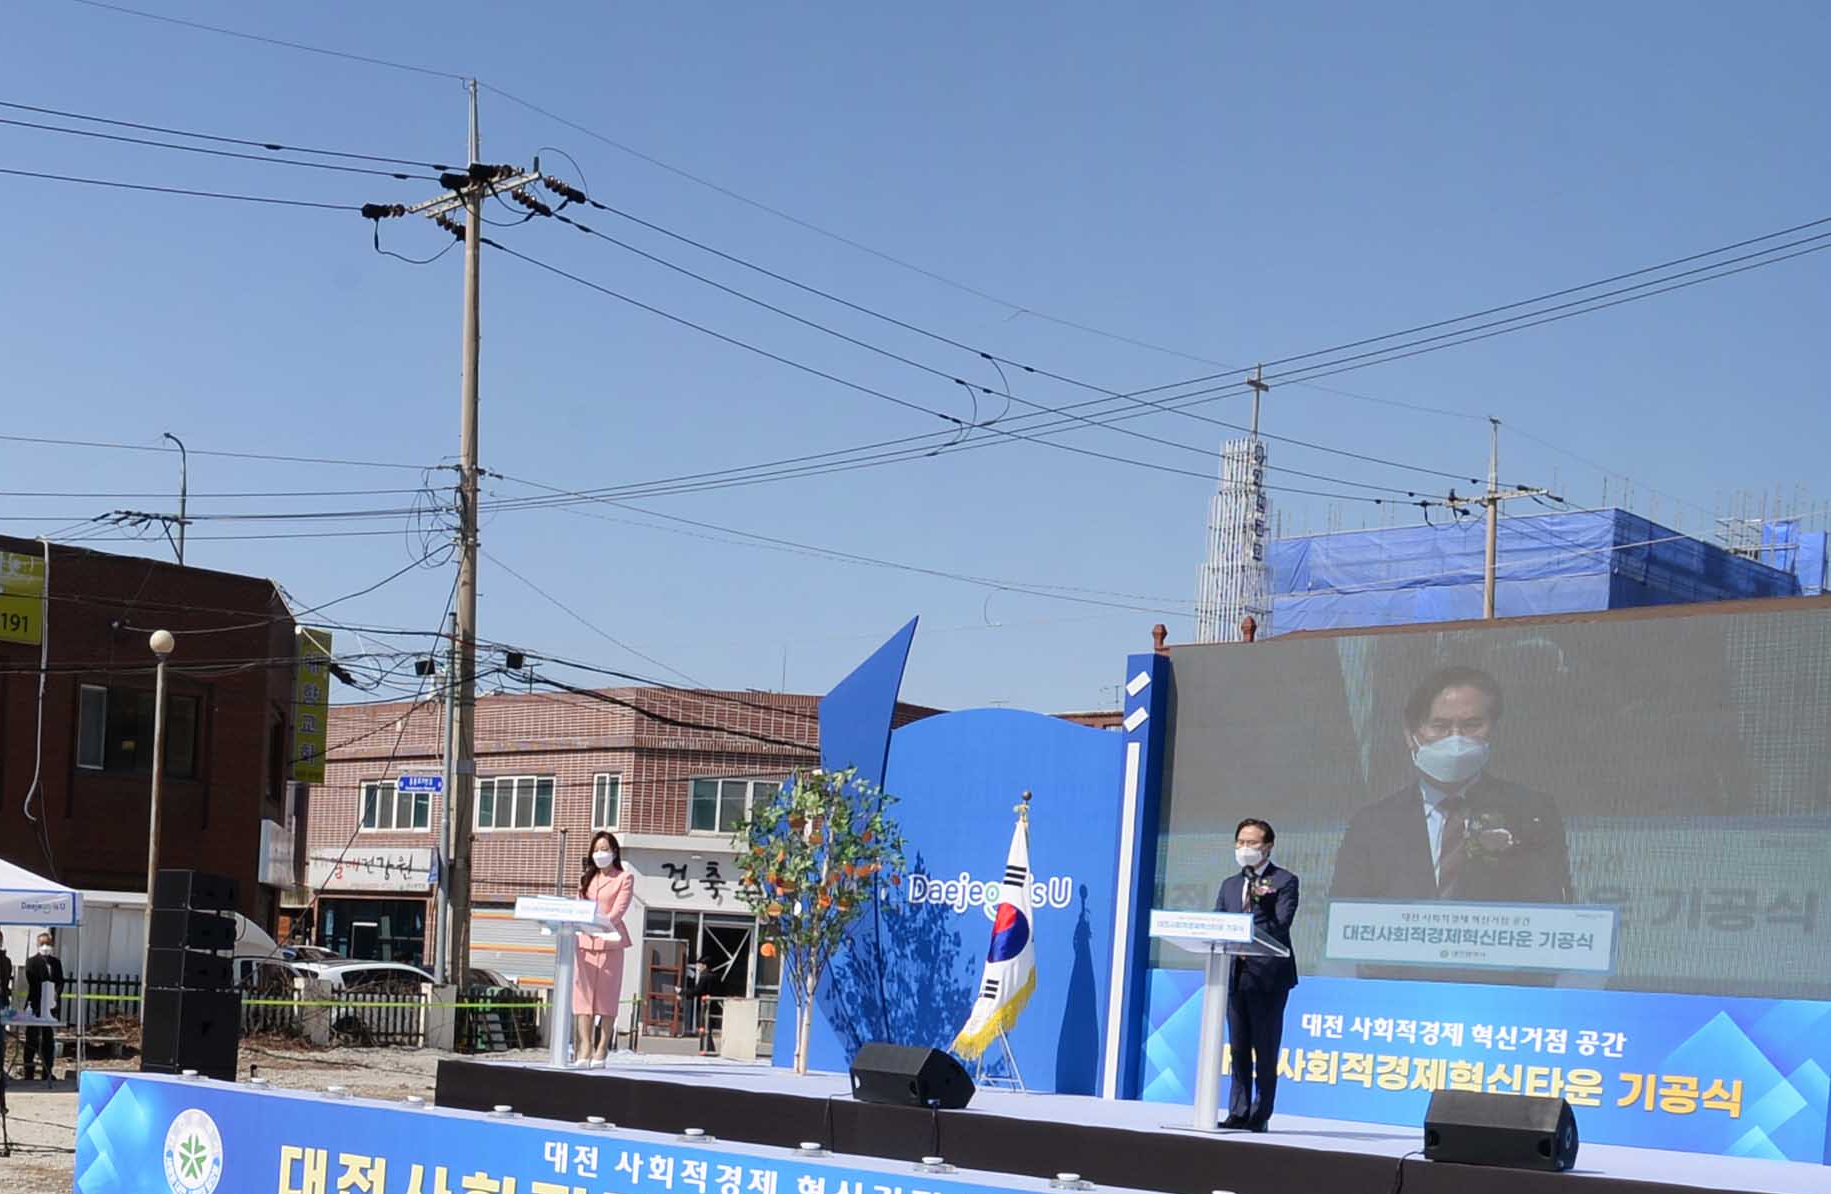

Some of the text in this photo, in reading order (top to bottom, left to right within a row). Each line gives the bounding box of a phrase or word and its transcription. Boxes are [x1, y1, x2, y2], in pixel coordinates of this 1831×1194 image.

[909, 872, 1001, 914] Daejeo
[1342, 924, 1594, 951] 대전사회적경제혁신타운 기공식
[1301, 1013, 1627, 1058] 대전 사회적경제 혁신거점 공간
[1617, 1072, 1744, 1119] 기공식
[544, 1140, 599, 1178] 대전
